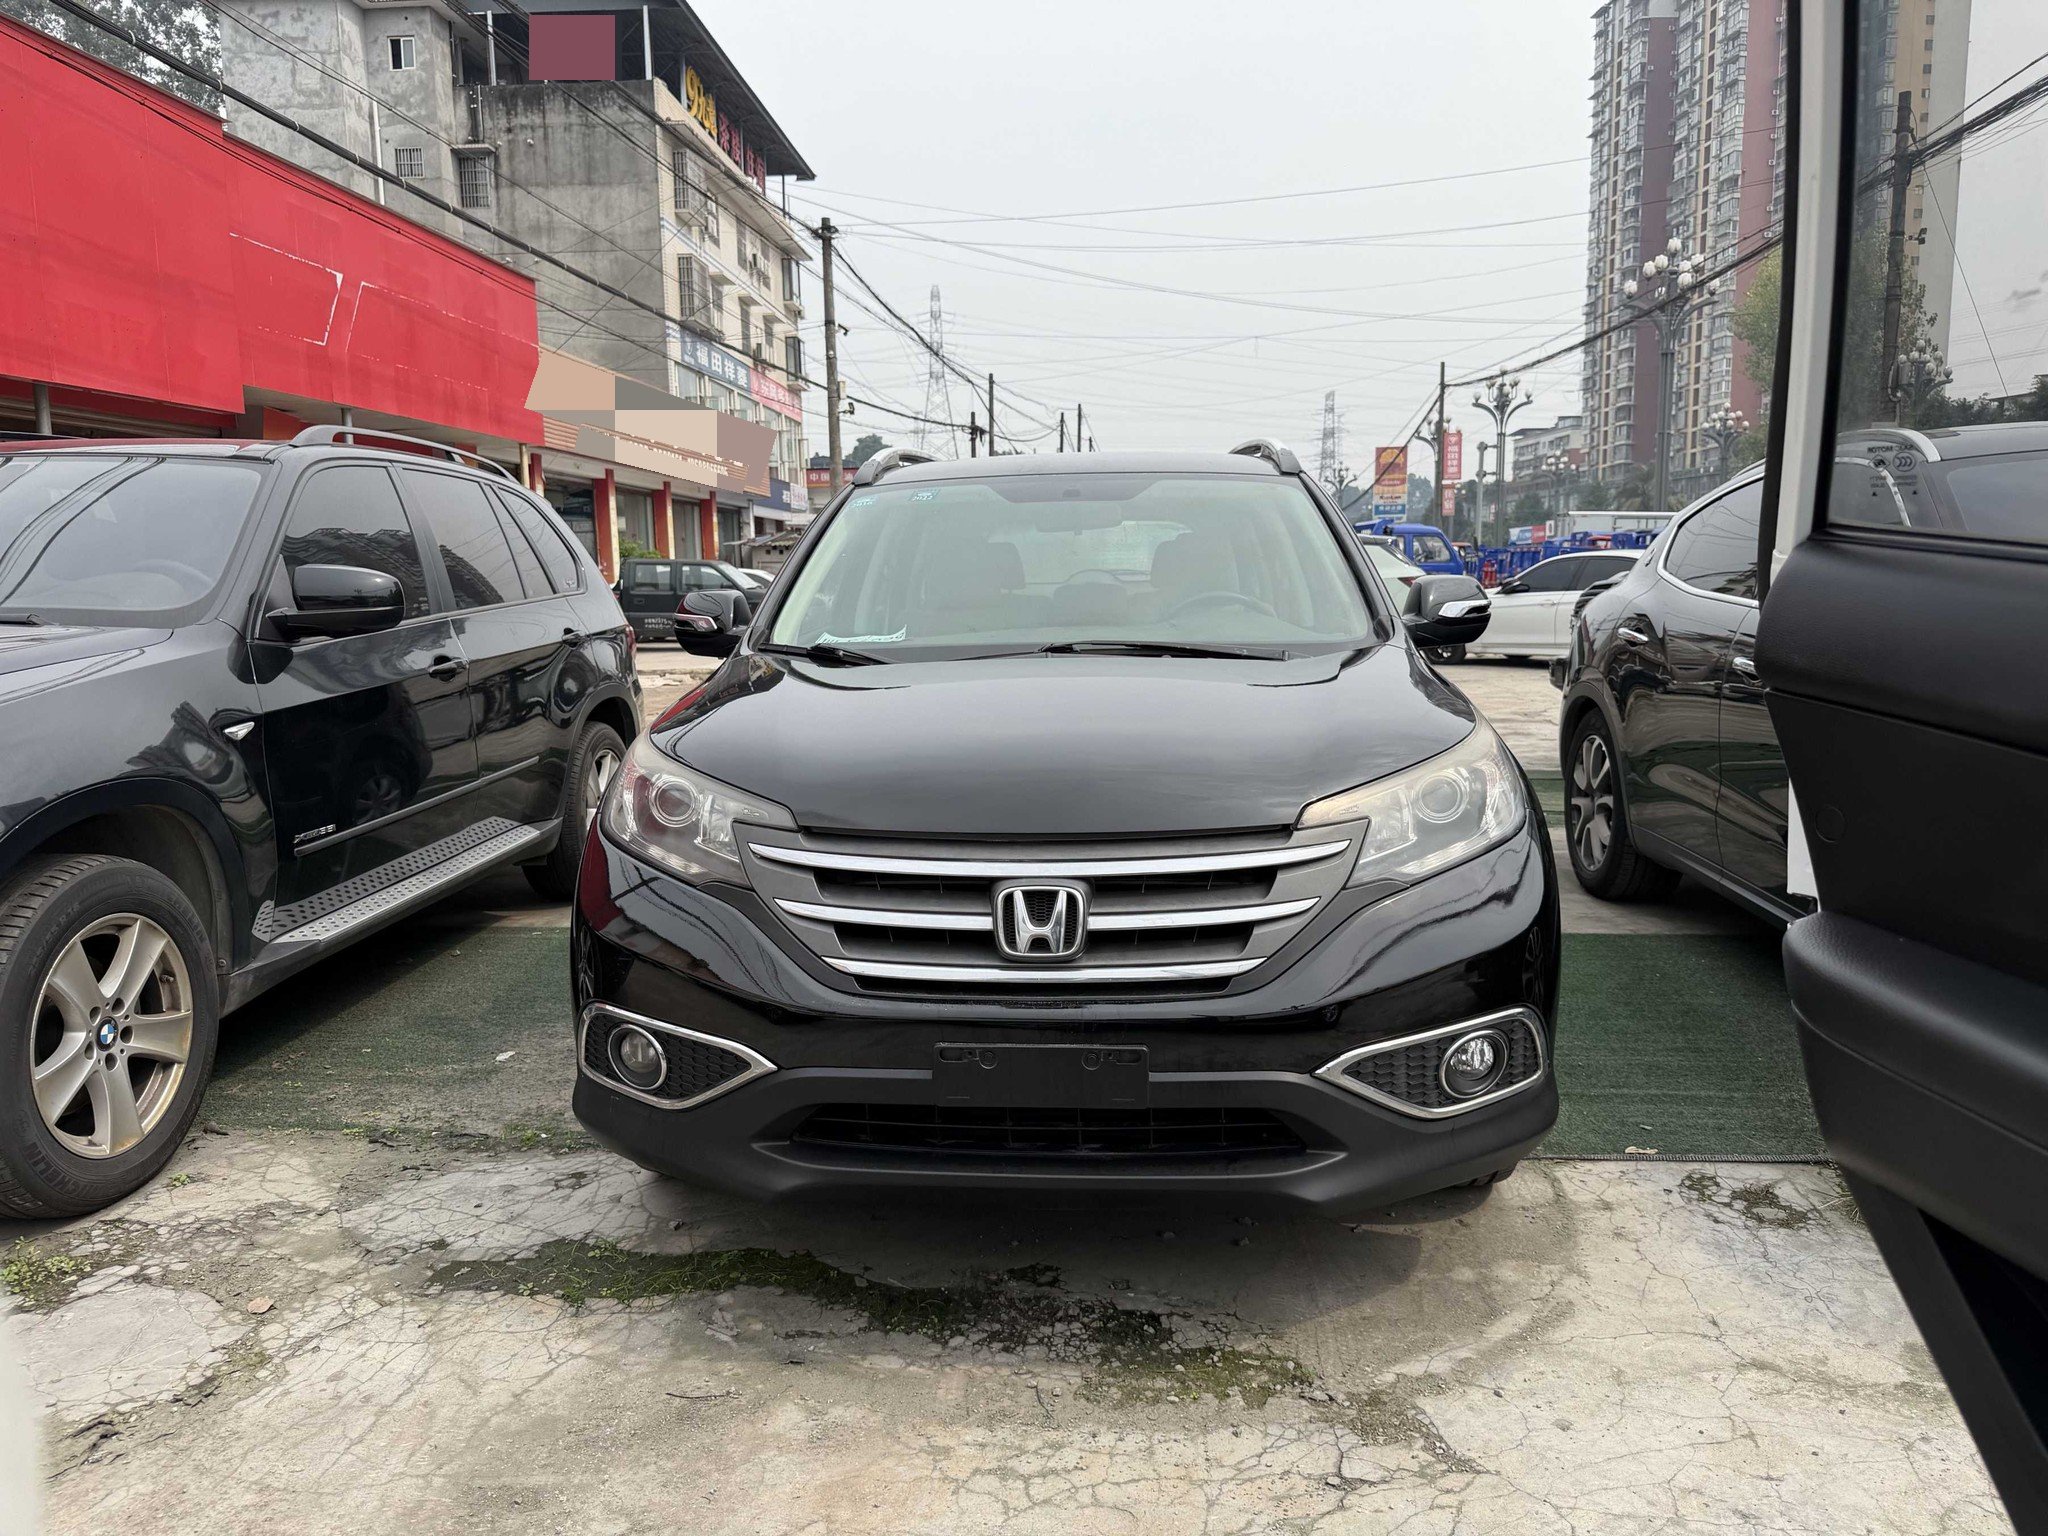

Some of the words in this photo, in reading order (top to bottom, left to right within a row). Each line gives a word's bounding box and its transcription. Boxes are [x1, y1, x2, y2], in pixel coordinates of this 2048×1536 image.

[696, 341, 748, 388] 福田祥菱
[809, 472, 854, 482] 中国油
